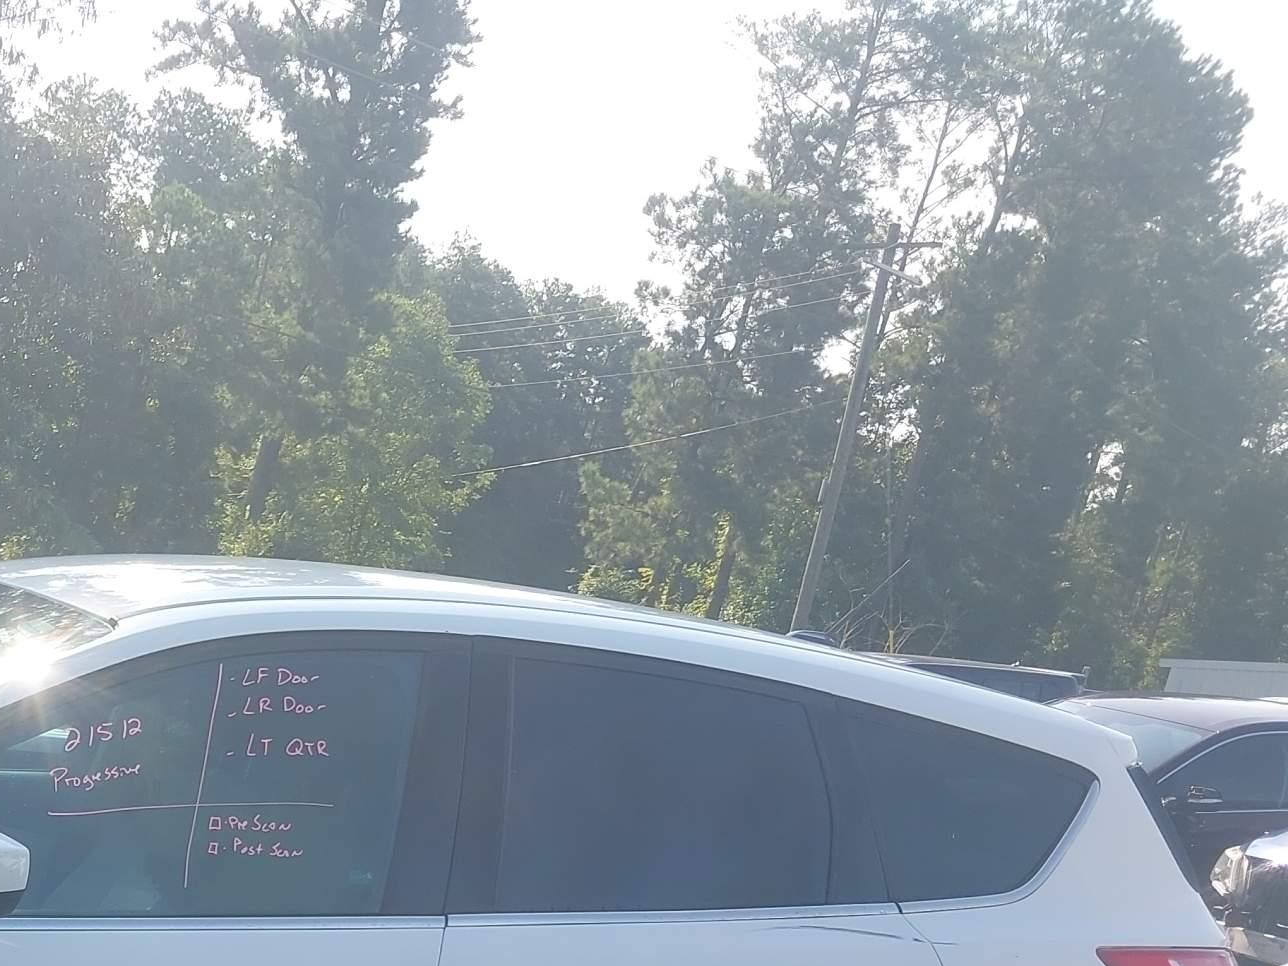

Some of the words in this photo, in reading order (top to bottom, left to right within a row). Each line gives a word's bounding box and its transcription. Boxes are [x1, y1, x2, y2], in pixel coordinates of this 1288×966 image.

[242, 668, 269, 686] LF
[277, 668, 320, 686] Door
[242, 697, 272, 714] LR
[283, 696, 327, 713] Door
[246, 733, 272, 756] LT
[286, 738, 329, 756] QTR
[49, 764, 141, 793] Progressive
[228, 816, 248, 831] Pre
[252, 814, 292, 832] Scan
[233, 837, 264, 855] Post
[269, 842, 304, 857] Scan
